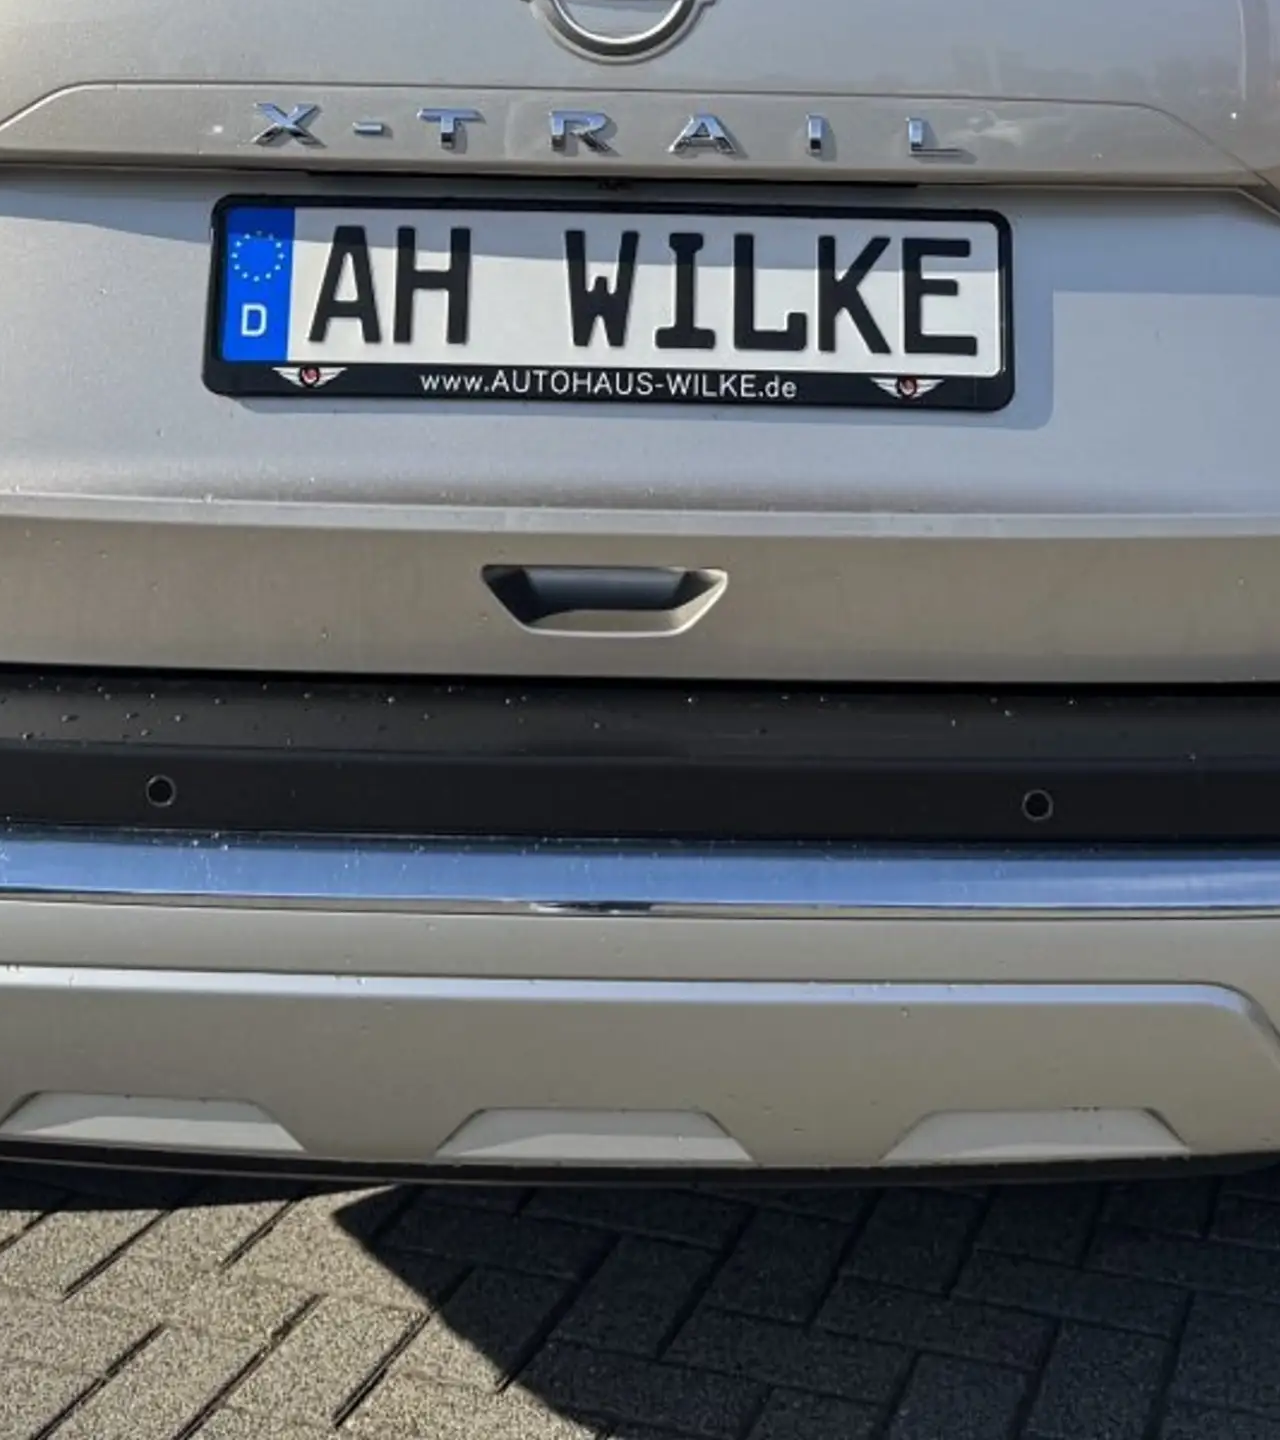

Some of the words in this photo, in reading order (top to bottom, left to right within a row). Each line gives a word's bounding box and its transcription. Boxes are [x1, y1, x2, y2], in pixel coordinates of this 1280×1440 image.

[253, 103, 964, 157] X-TRAIL
[308, 226, 472, 345] AH
[563, 230, 978, 356] WILKE
[241, 305, 267, 337] D
[419, 368, 797, 401] www.AUTOHAUS-WILKE.de
